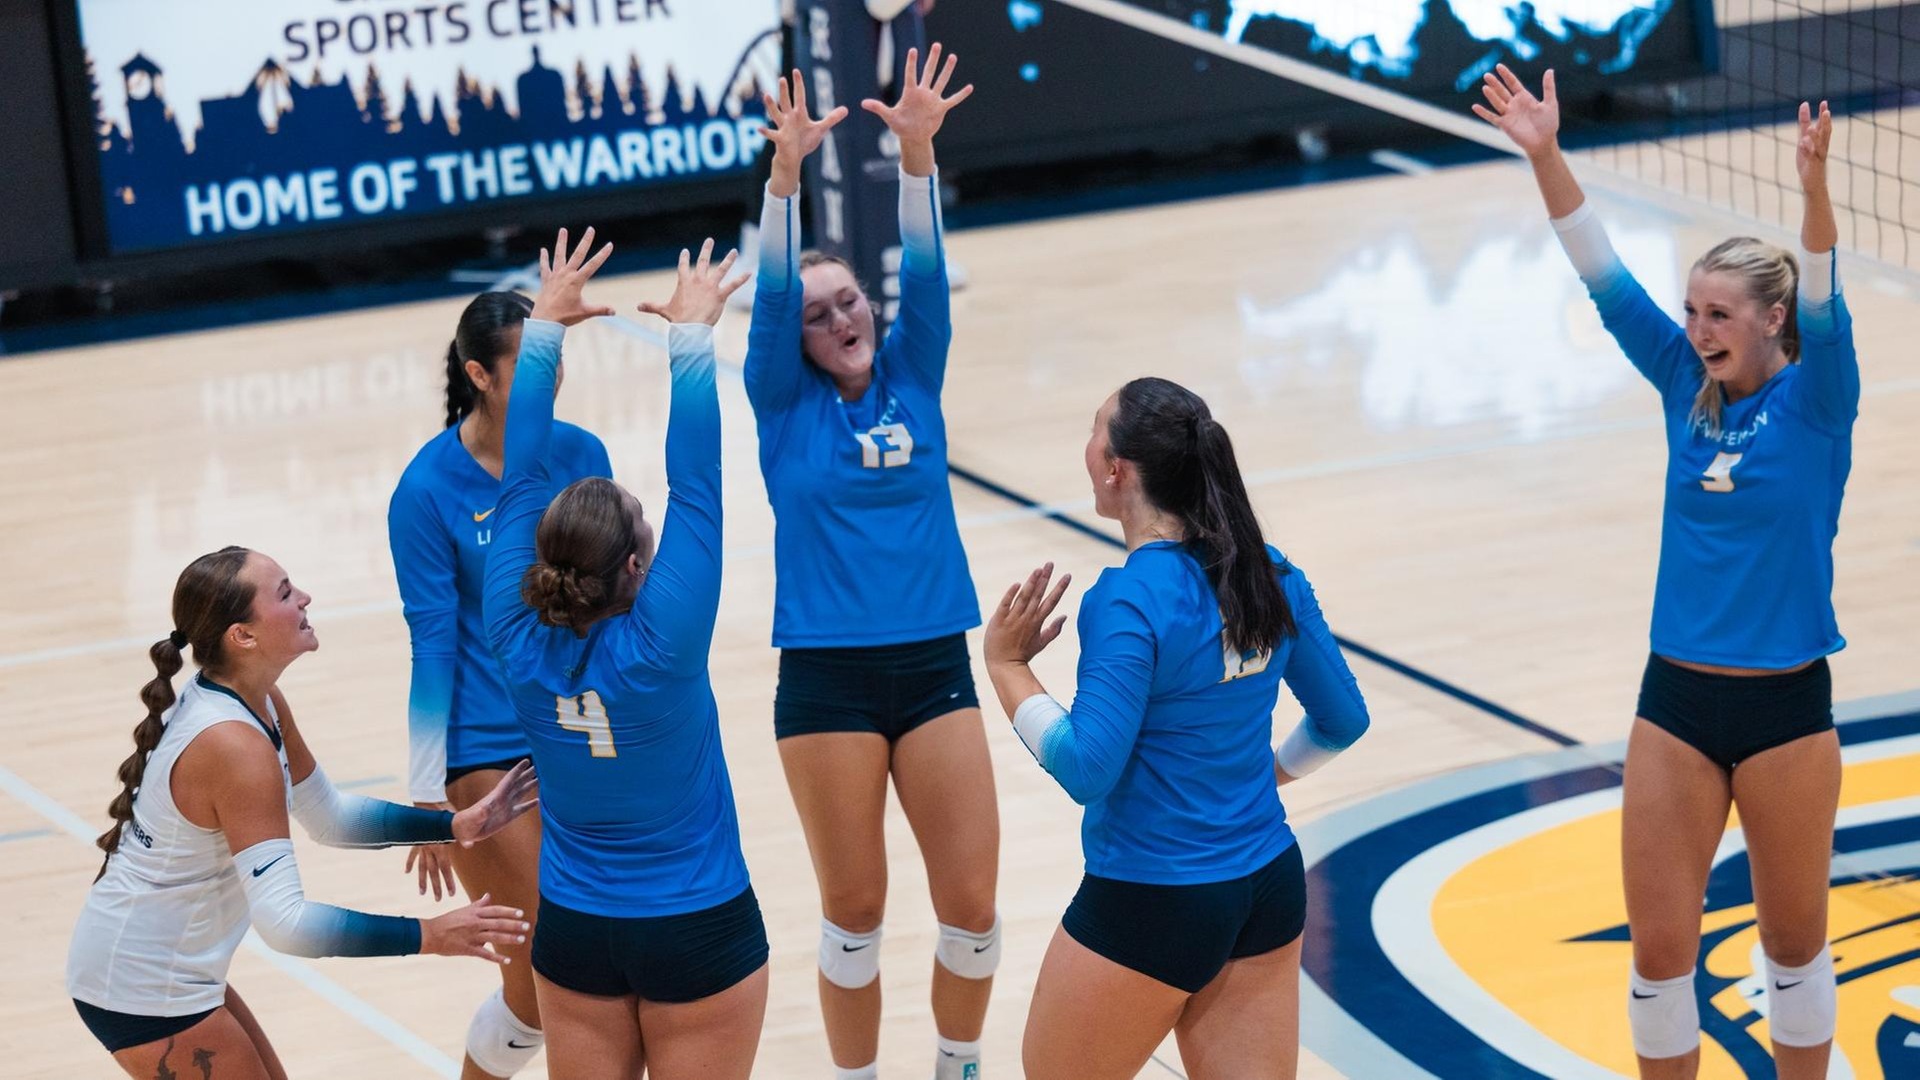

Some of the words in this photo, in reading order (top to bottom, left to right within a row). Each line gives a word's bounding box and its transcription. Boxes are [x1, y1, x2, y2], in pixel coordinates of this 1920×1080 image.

[284, 3, 471, 62] SPORTS
[184, 166, 344, 236] HOME
[349, 157, 418, 215] OF
[425, 146, 533, 204] THE
[854, 423, 913, 468] 13
[556, 690, 617, 758] 4
